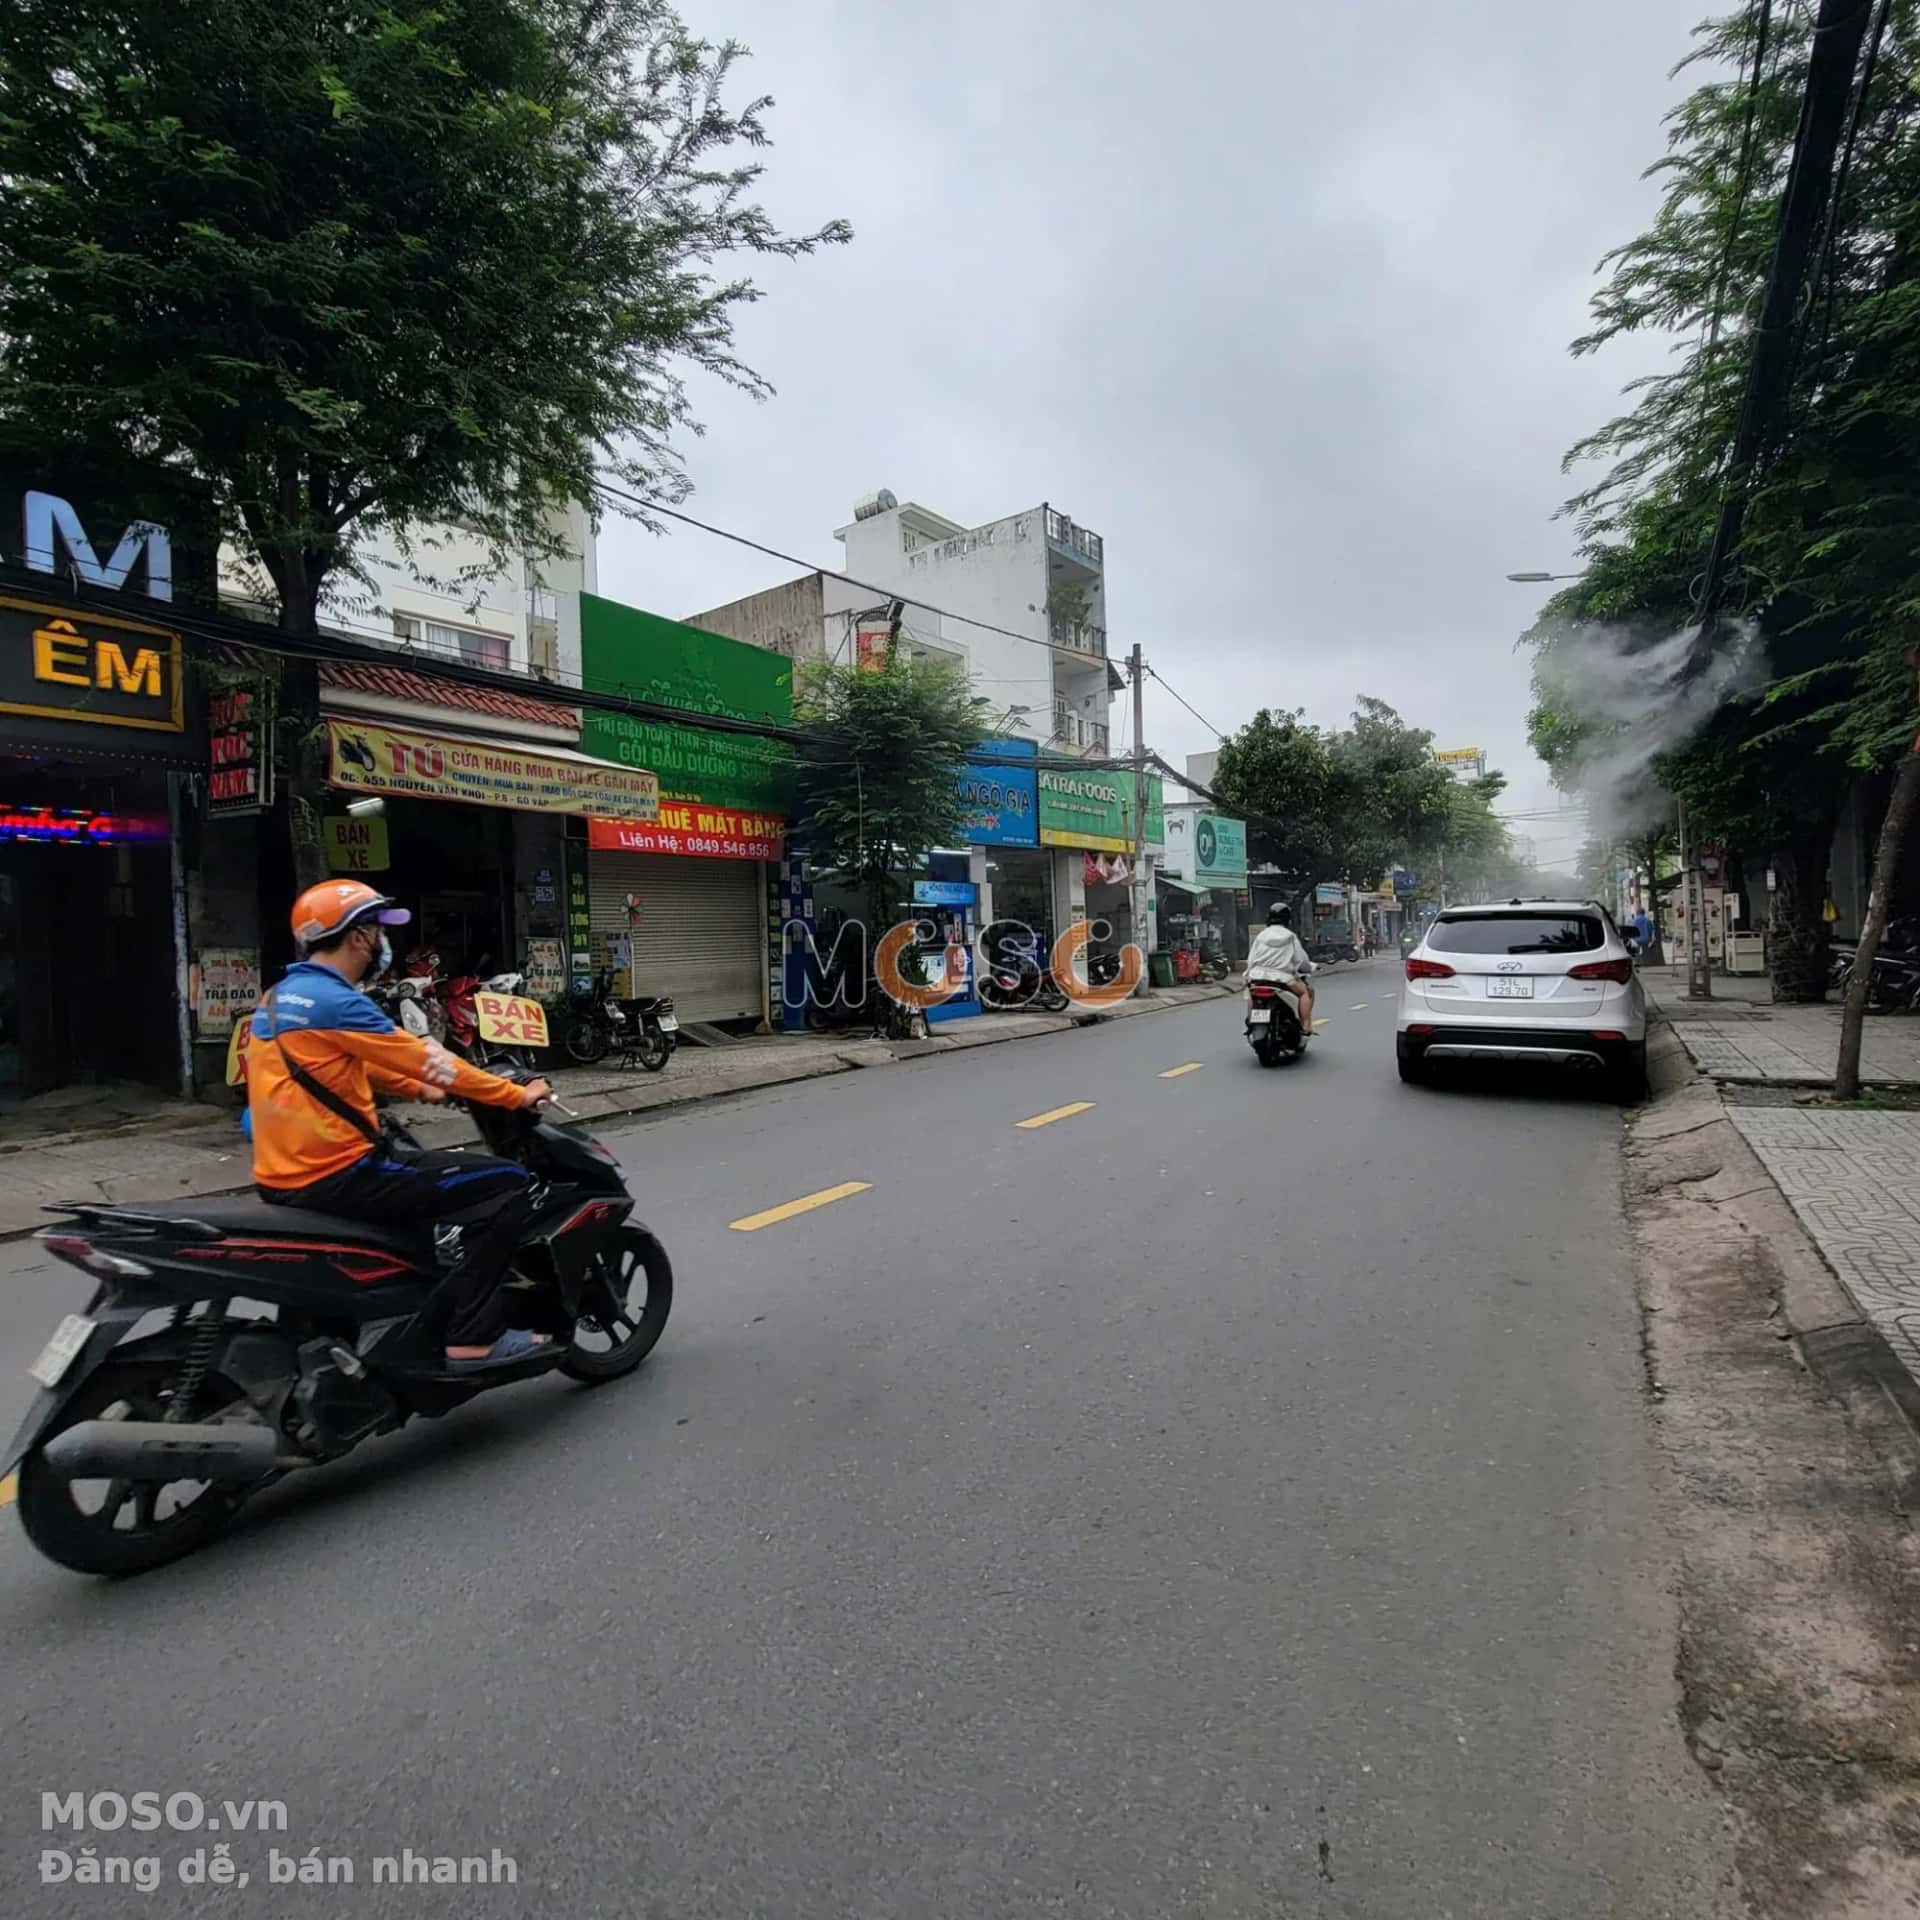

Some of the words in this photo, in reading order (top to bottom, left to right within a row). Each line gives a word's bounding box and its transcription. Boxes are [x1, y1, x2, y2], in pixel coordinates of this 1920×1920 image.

[0, 490, 172, 602] M
[33, 619, 161, 696] ÊM
[526, 763, 553, 780] MUA
[698, 812, 736, 838] MẶT
[619, 831, 655, 848] Liên
[658, 834, 683, 854] Hệ:
[481, 996, 543, 1024] BÁN
[491, 1019, 544, 1042] XE
